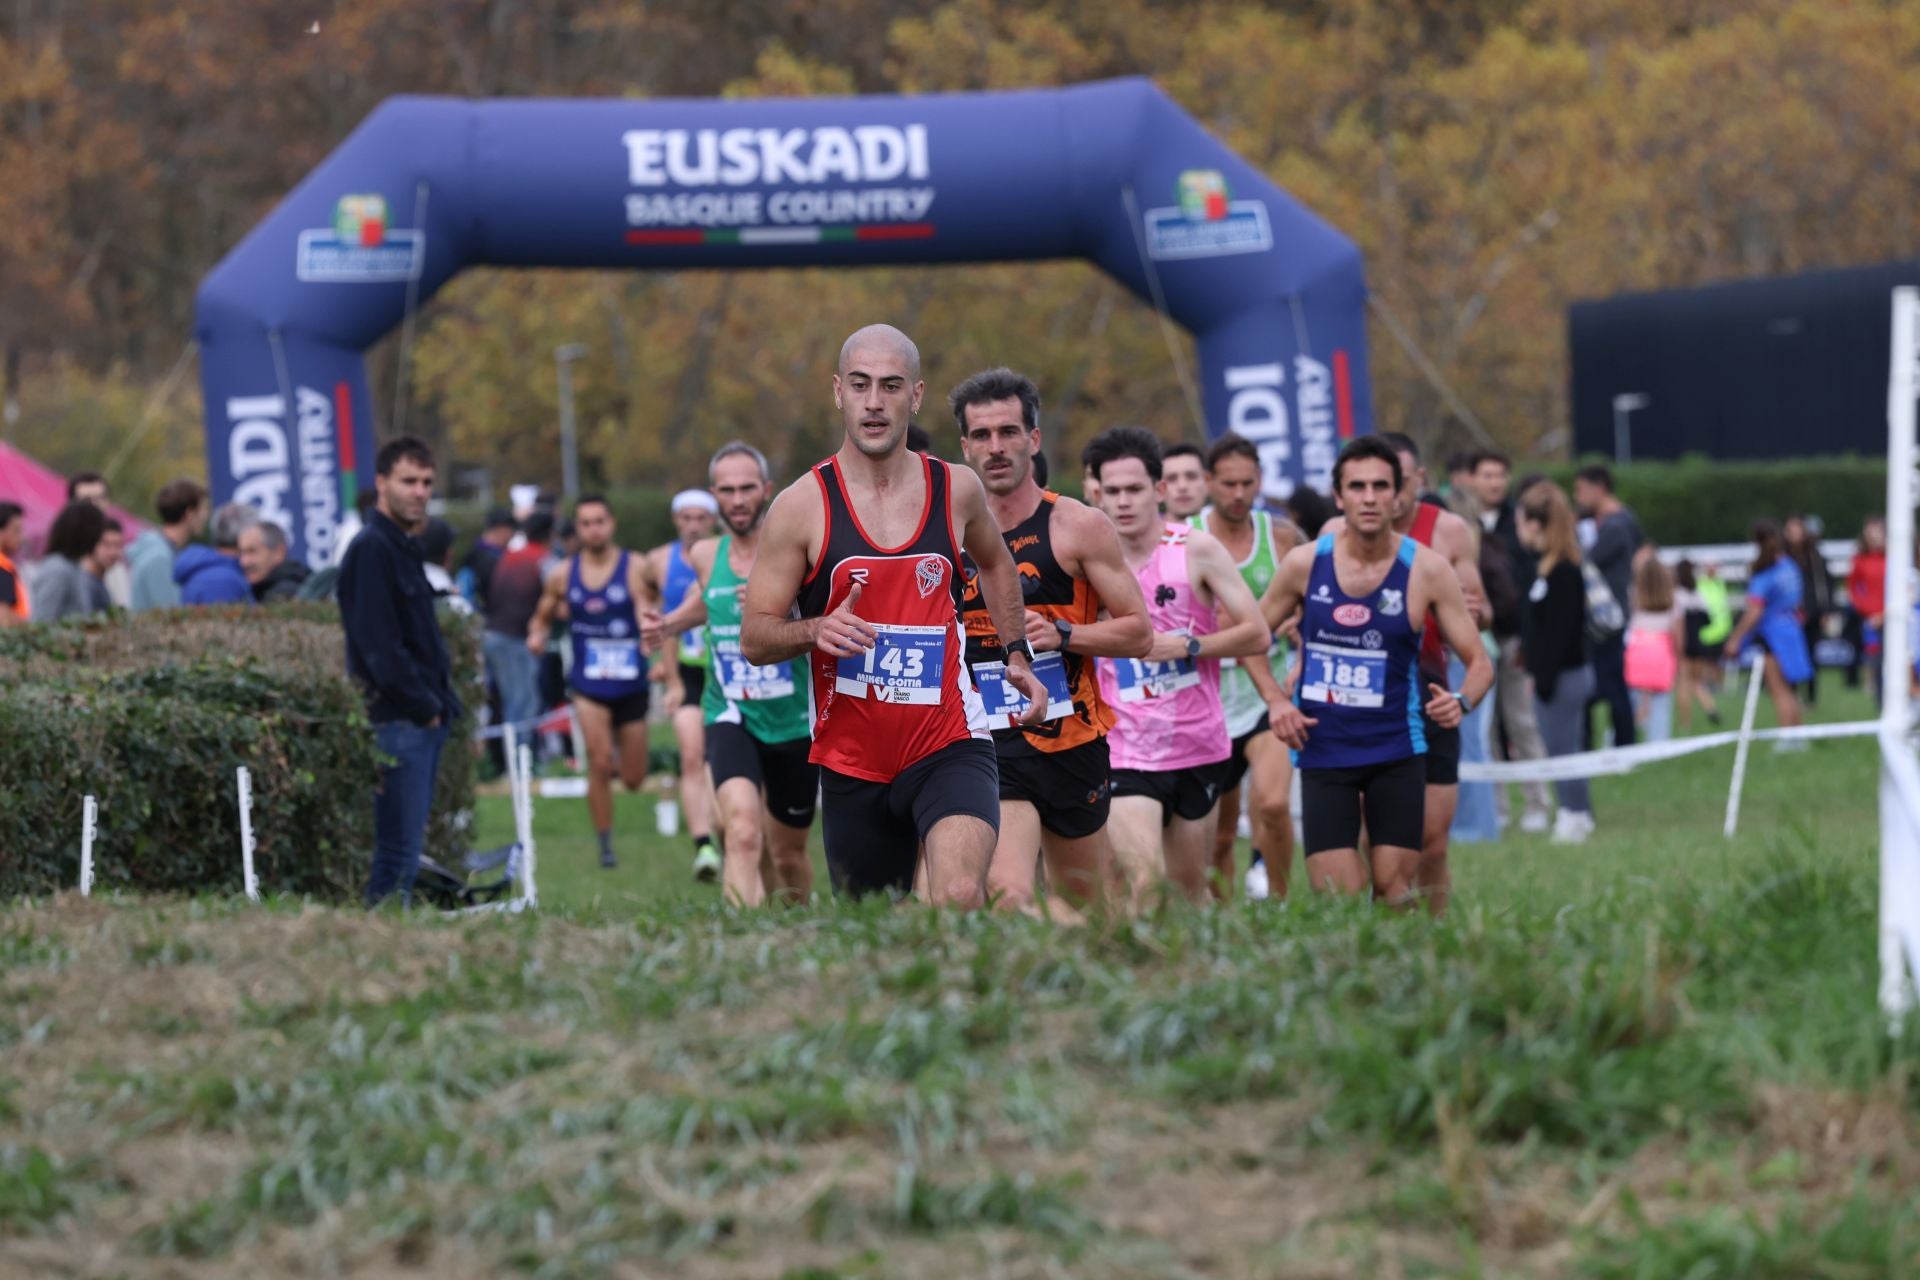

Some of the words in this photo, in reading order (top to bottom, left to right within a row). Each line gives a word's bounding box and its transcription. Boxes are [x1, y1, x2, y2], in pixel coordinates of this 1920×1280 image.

[622, 124, 930, 186] EUSKADI
[624, 192, 763, 226] BASQUE
[767, 187, 935, 224] COUNTRY
[862, 644, 924, 677] 143
[1322, 660, 1370, 688] 188
[856, 673, 885, 686] MIKEL
[887, 677, 922, 688] GOITIA
